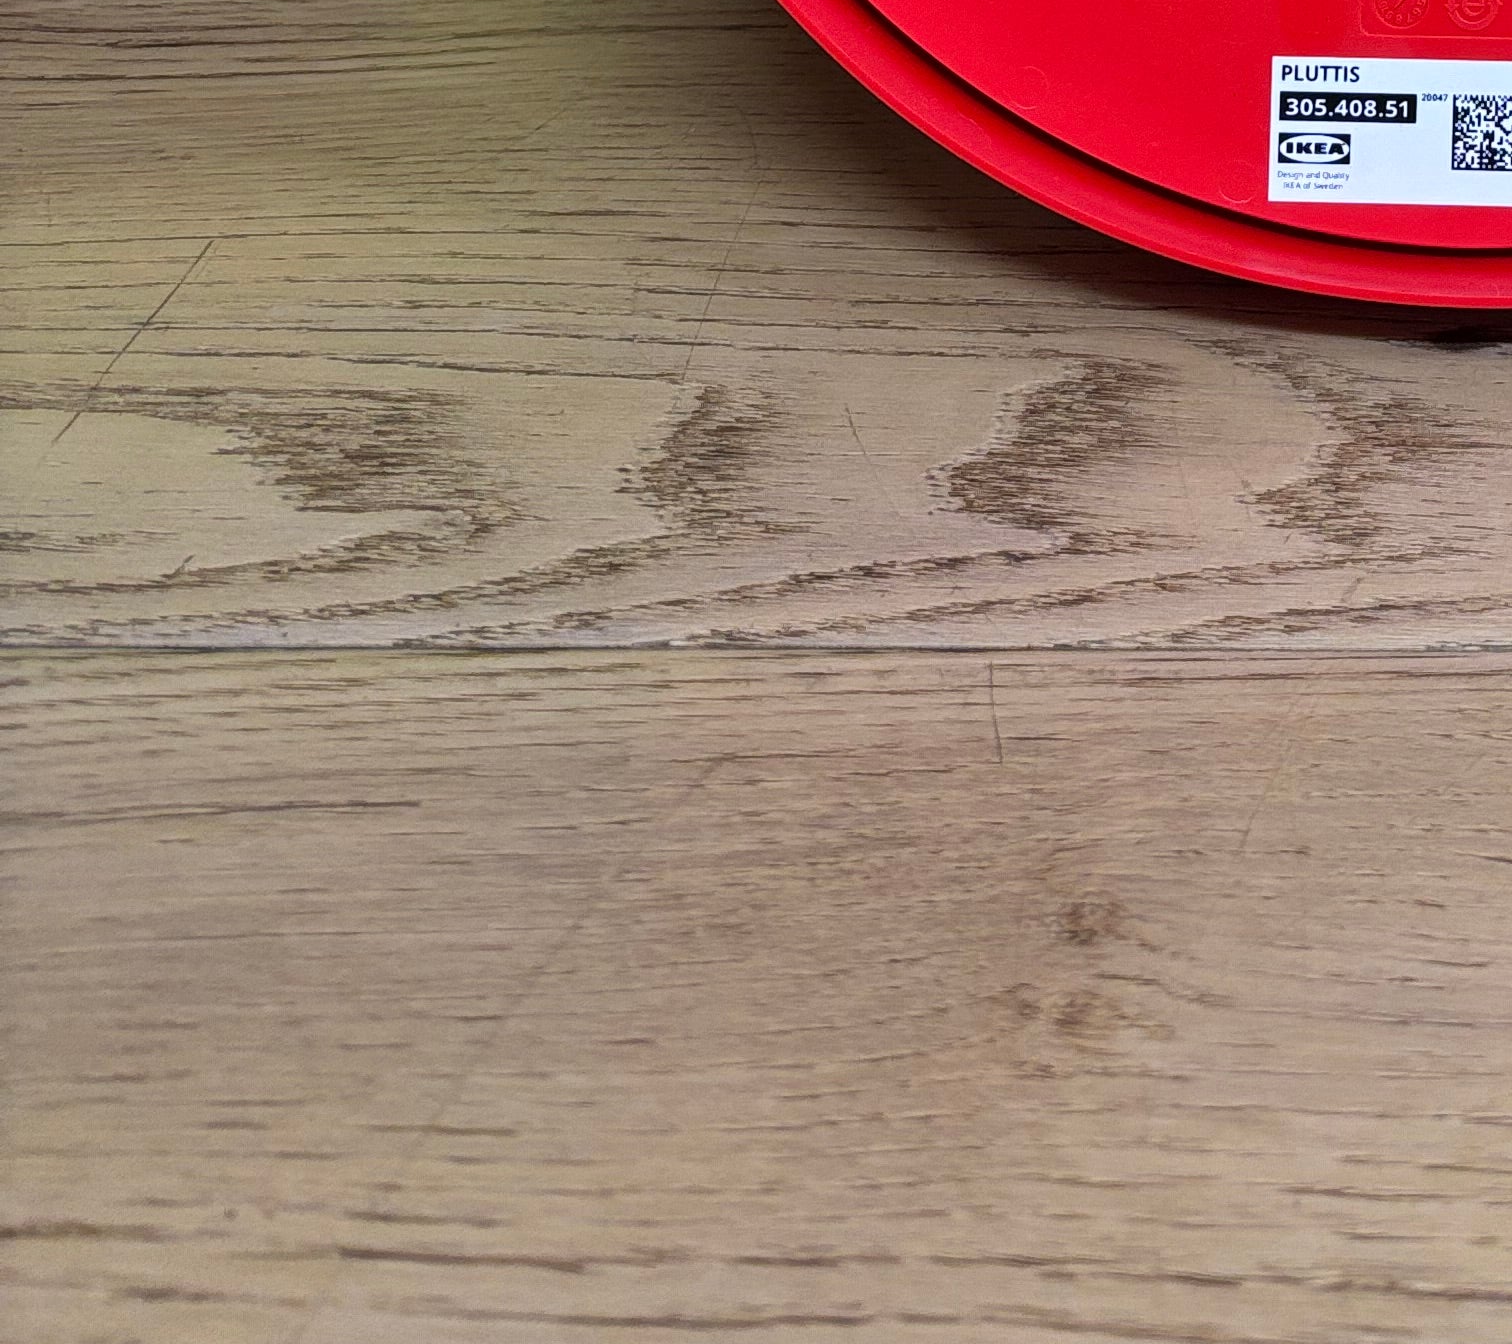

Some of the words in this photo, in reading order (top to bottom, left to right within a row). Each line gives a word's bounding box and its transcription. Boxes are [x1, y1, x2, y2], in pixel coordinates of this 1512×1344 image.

[1281, 64, 1360, 83] PLUTTIS
[1421, 93, 1448, 102] 20047
[1285, 98, 1409, 118] 305.408.51
[1285, 142, 1346, 155] IKEA
[1277, 171, 1303, 180] Design
[1306, 171, 1320, 179] and
